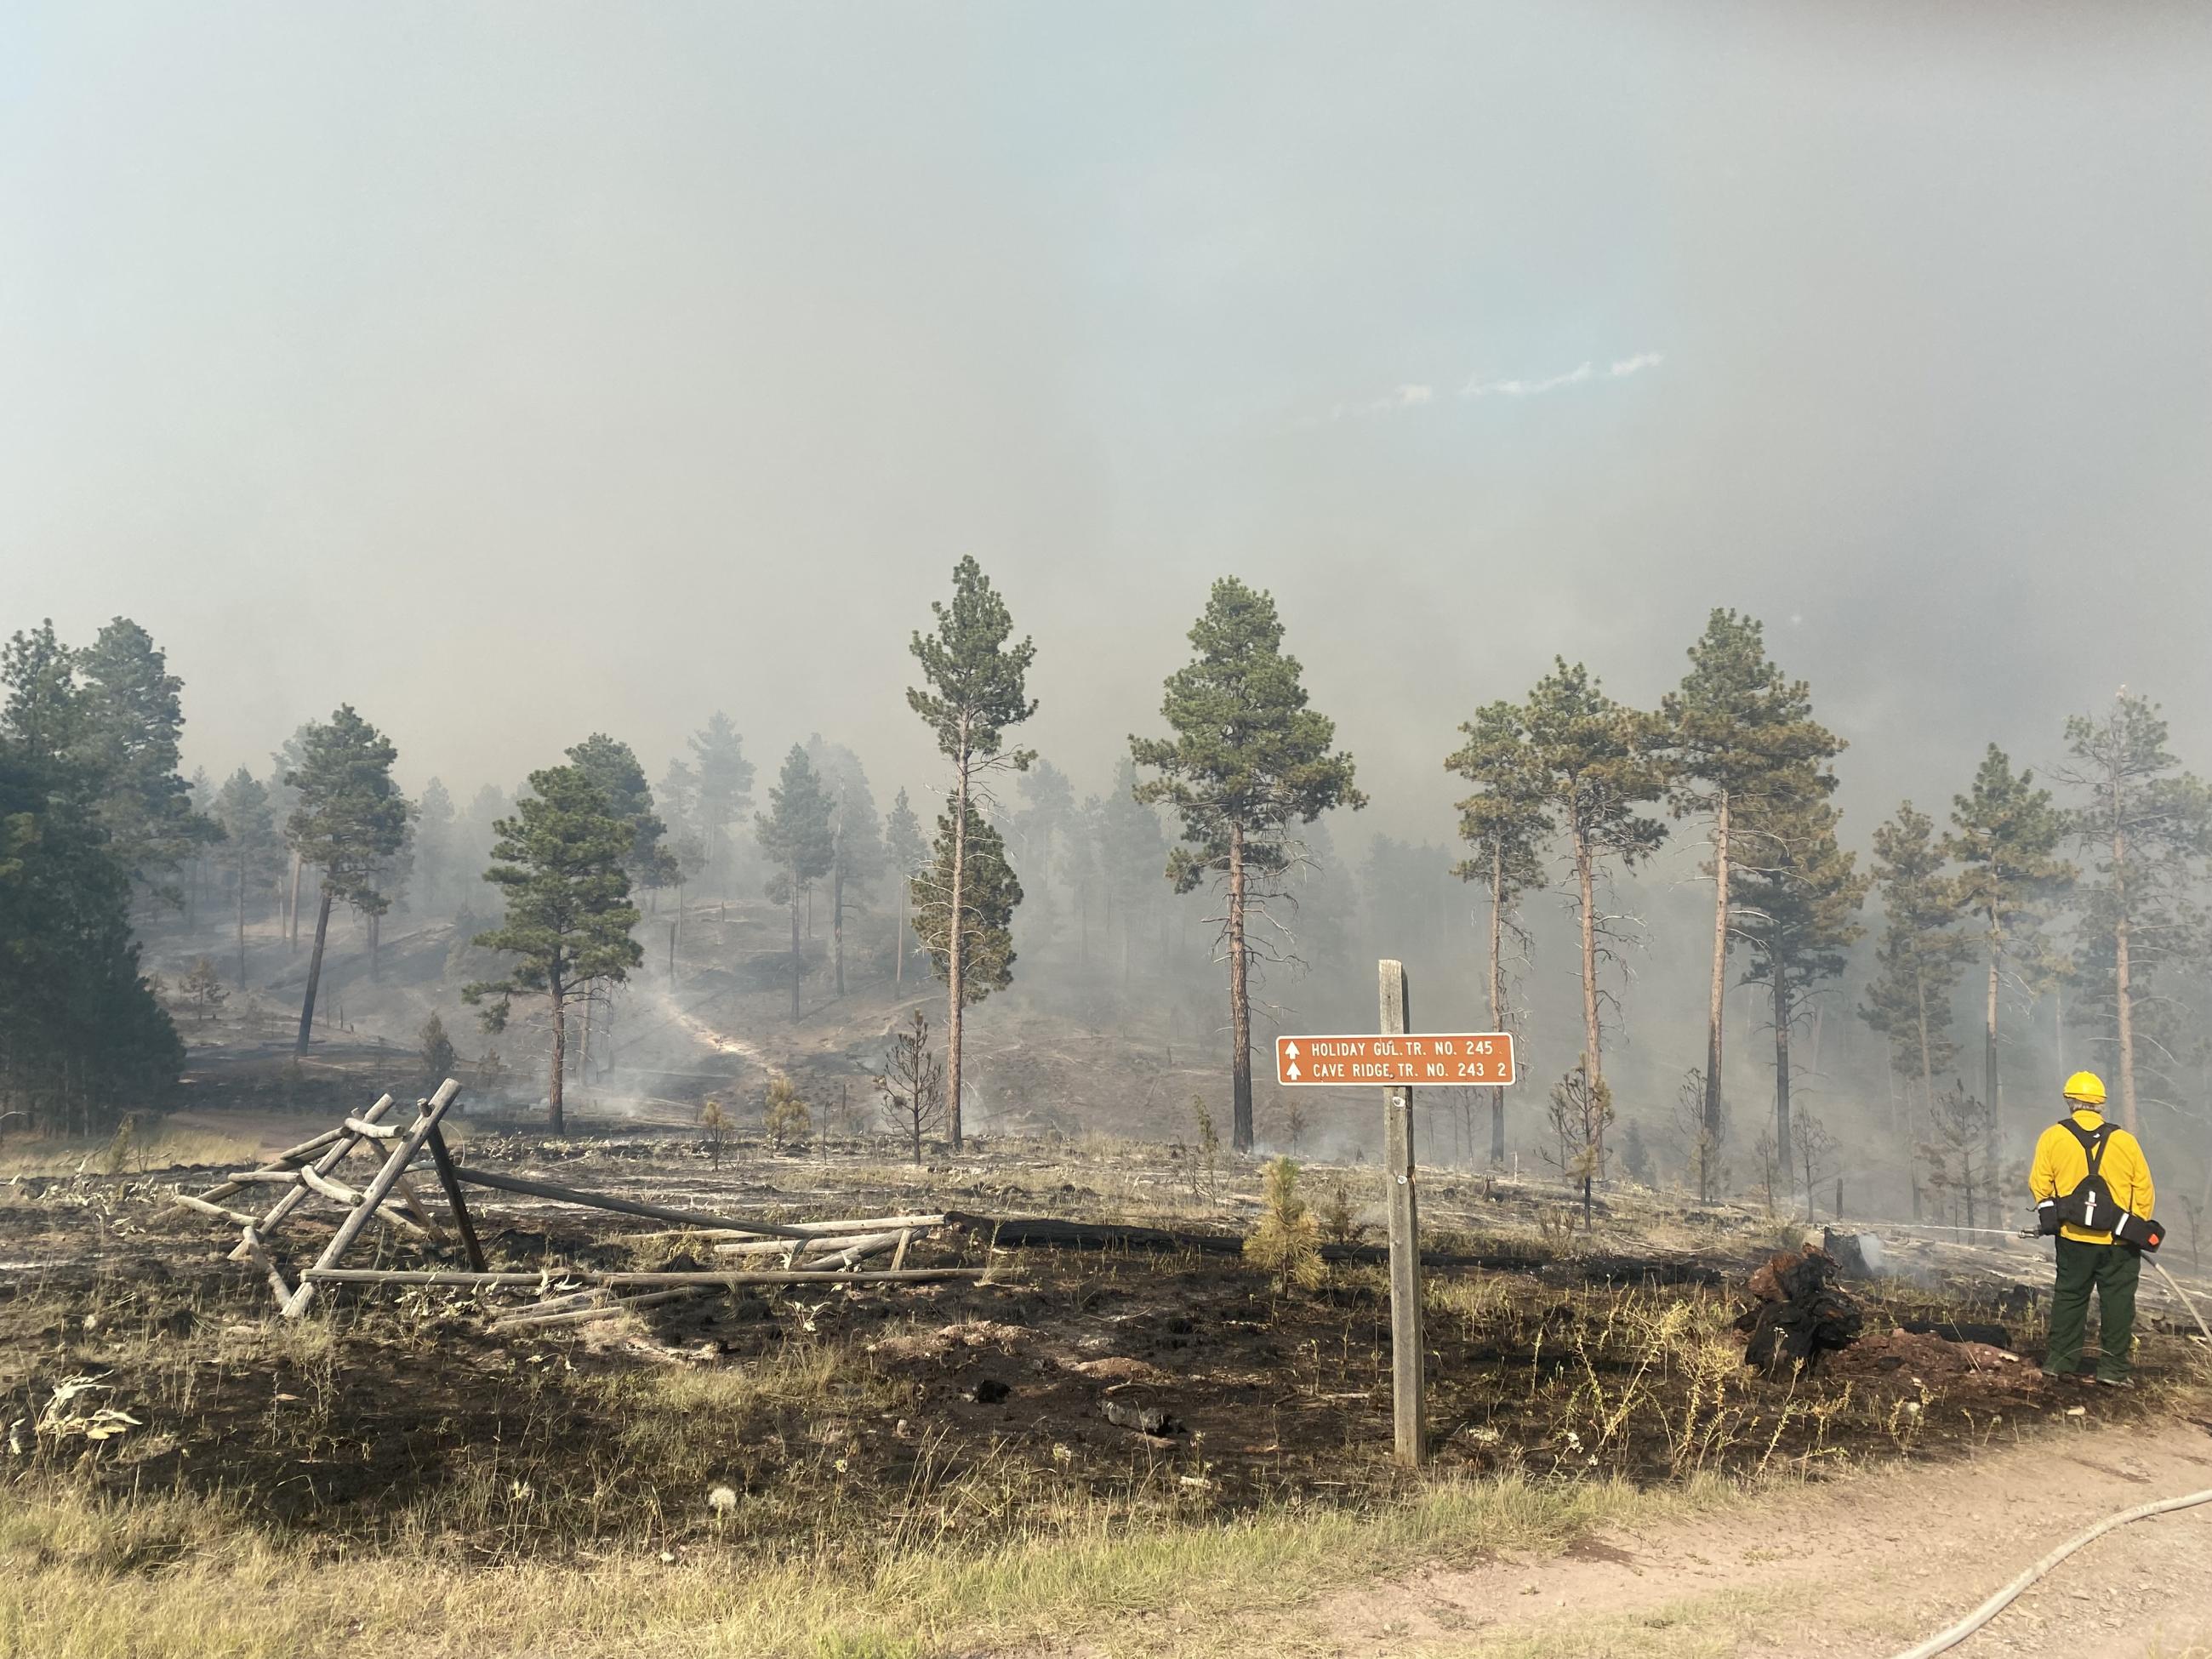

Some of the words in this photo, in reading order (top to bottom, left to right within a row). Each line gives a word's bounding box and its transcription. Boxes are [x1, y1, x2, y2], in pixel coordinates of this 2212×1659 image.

[1311, 1043, 1365, 1057] HOLIDAY
[1405, 1041, 1427, 1056] TR.
[1434, 1040, 1457, 1056] NO.
[1466, 1040, 1493, 1055] 245
[1313, 1063, 1345, 1077] CAVE
[1397, 1063, 1418, 1077] TR.
[1427, 1063, 1449, 1077] NO.
[1457, 1062, 1485, 1076] 243
[1497, 1062, 1507, 1076] 2
